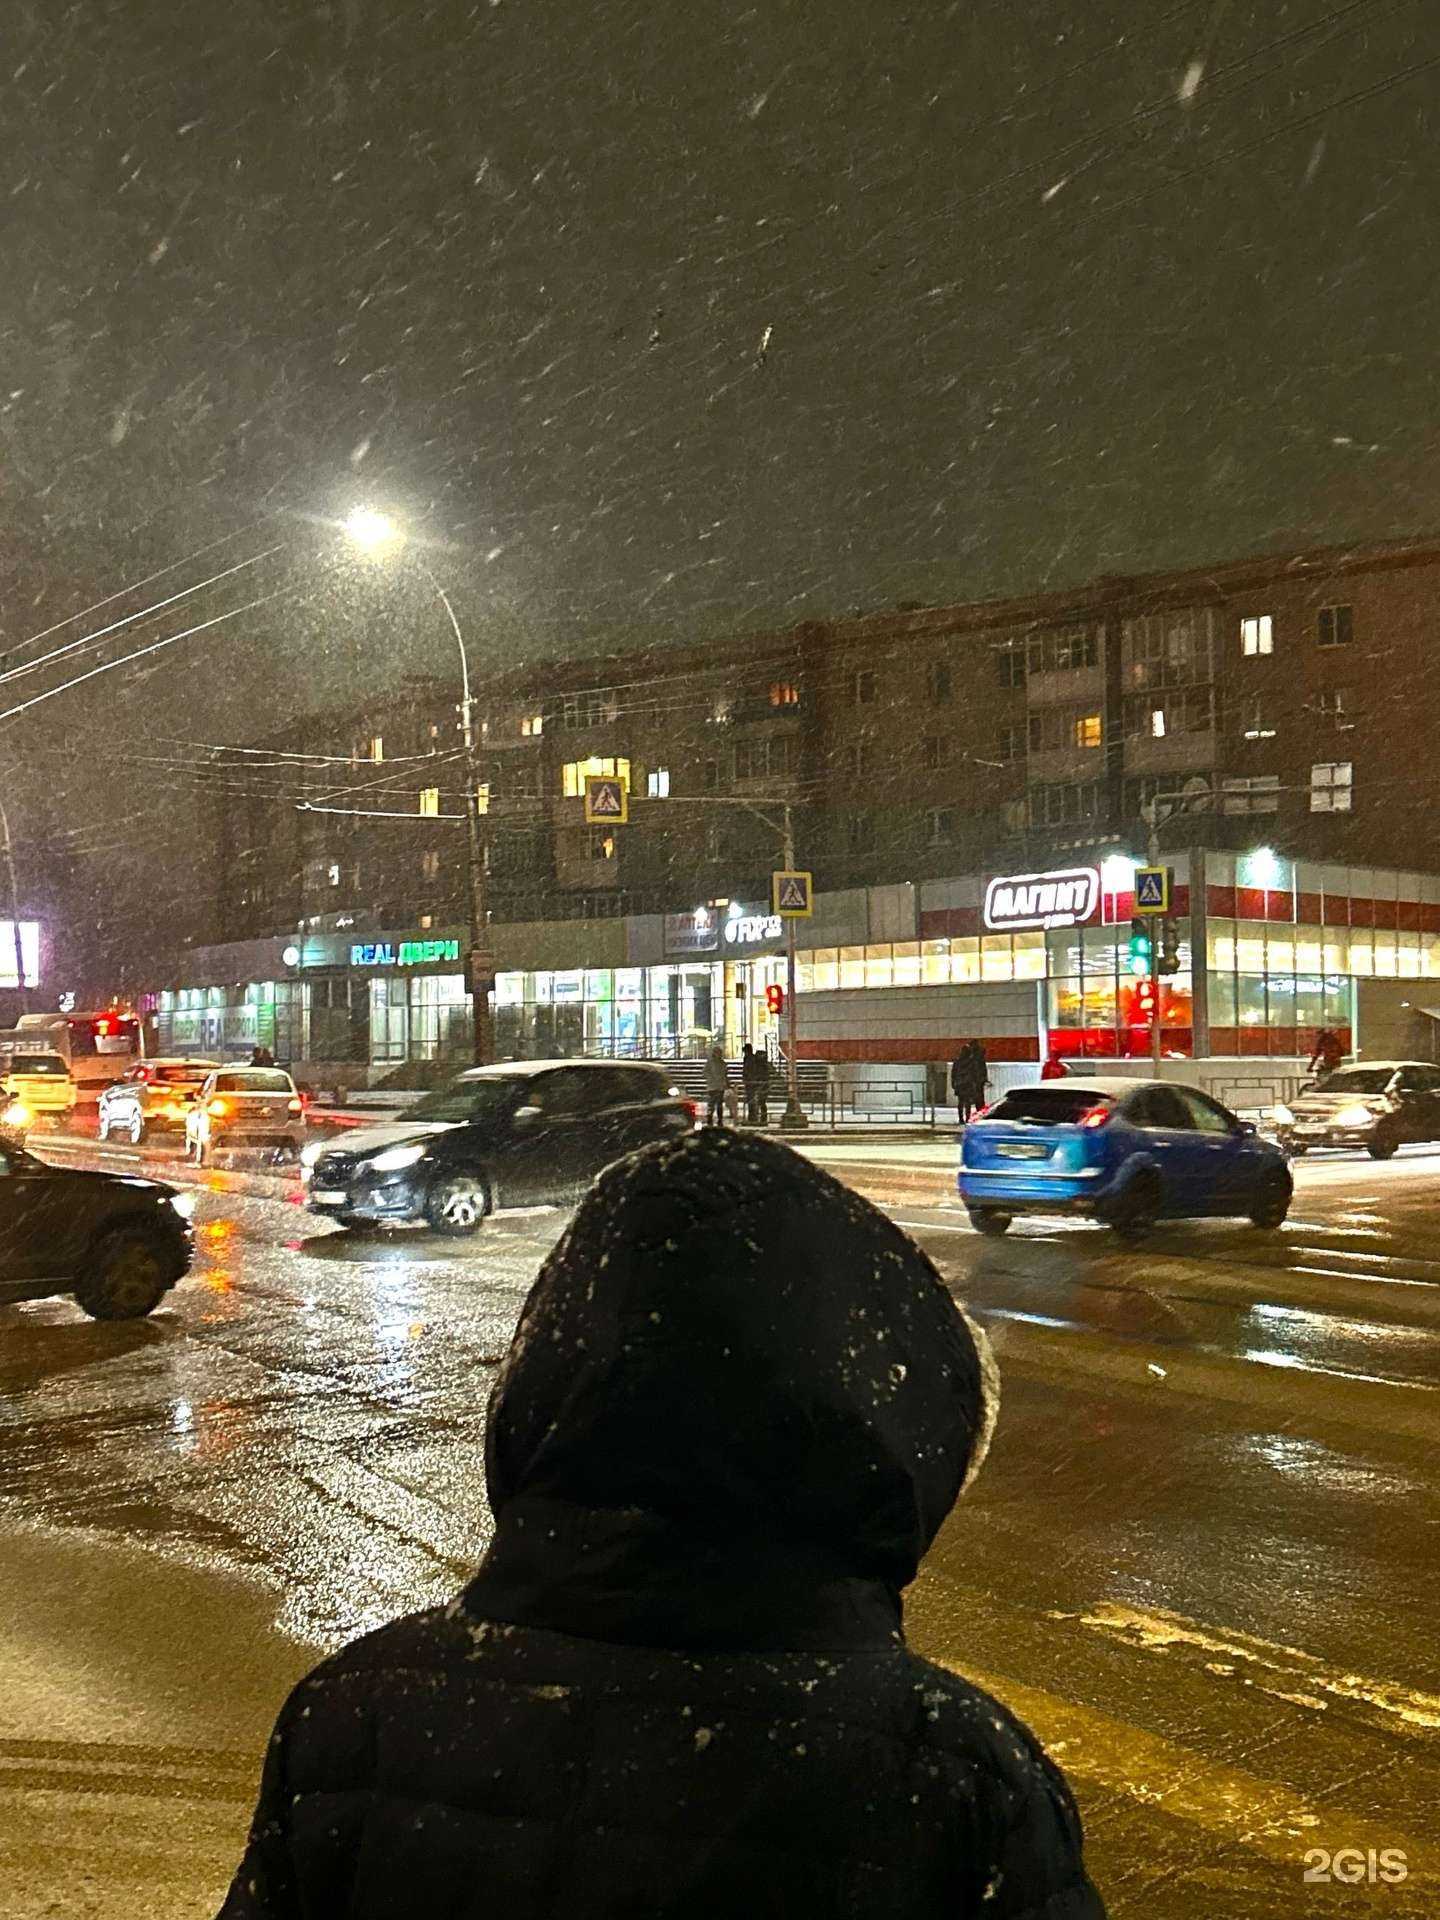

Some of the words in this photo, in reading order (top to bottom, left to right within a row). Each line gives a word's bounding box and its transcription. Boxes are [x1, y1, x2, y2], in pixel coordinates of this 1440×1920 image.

[992, 880, 1090, 918] МАГНИТ
[352, 944, 396, 965] REAL
[398, 940, 459, 965] ДВЕРИ
